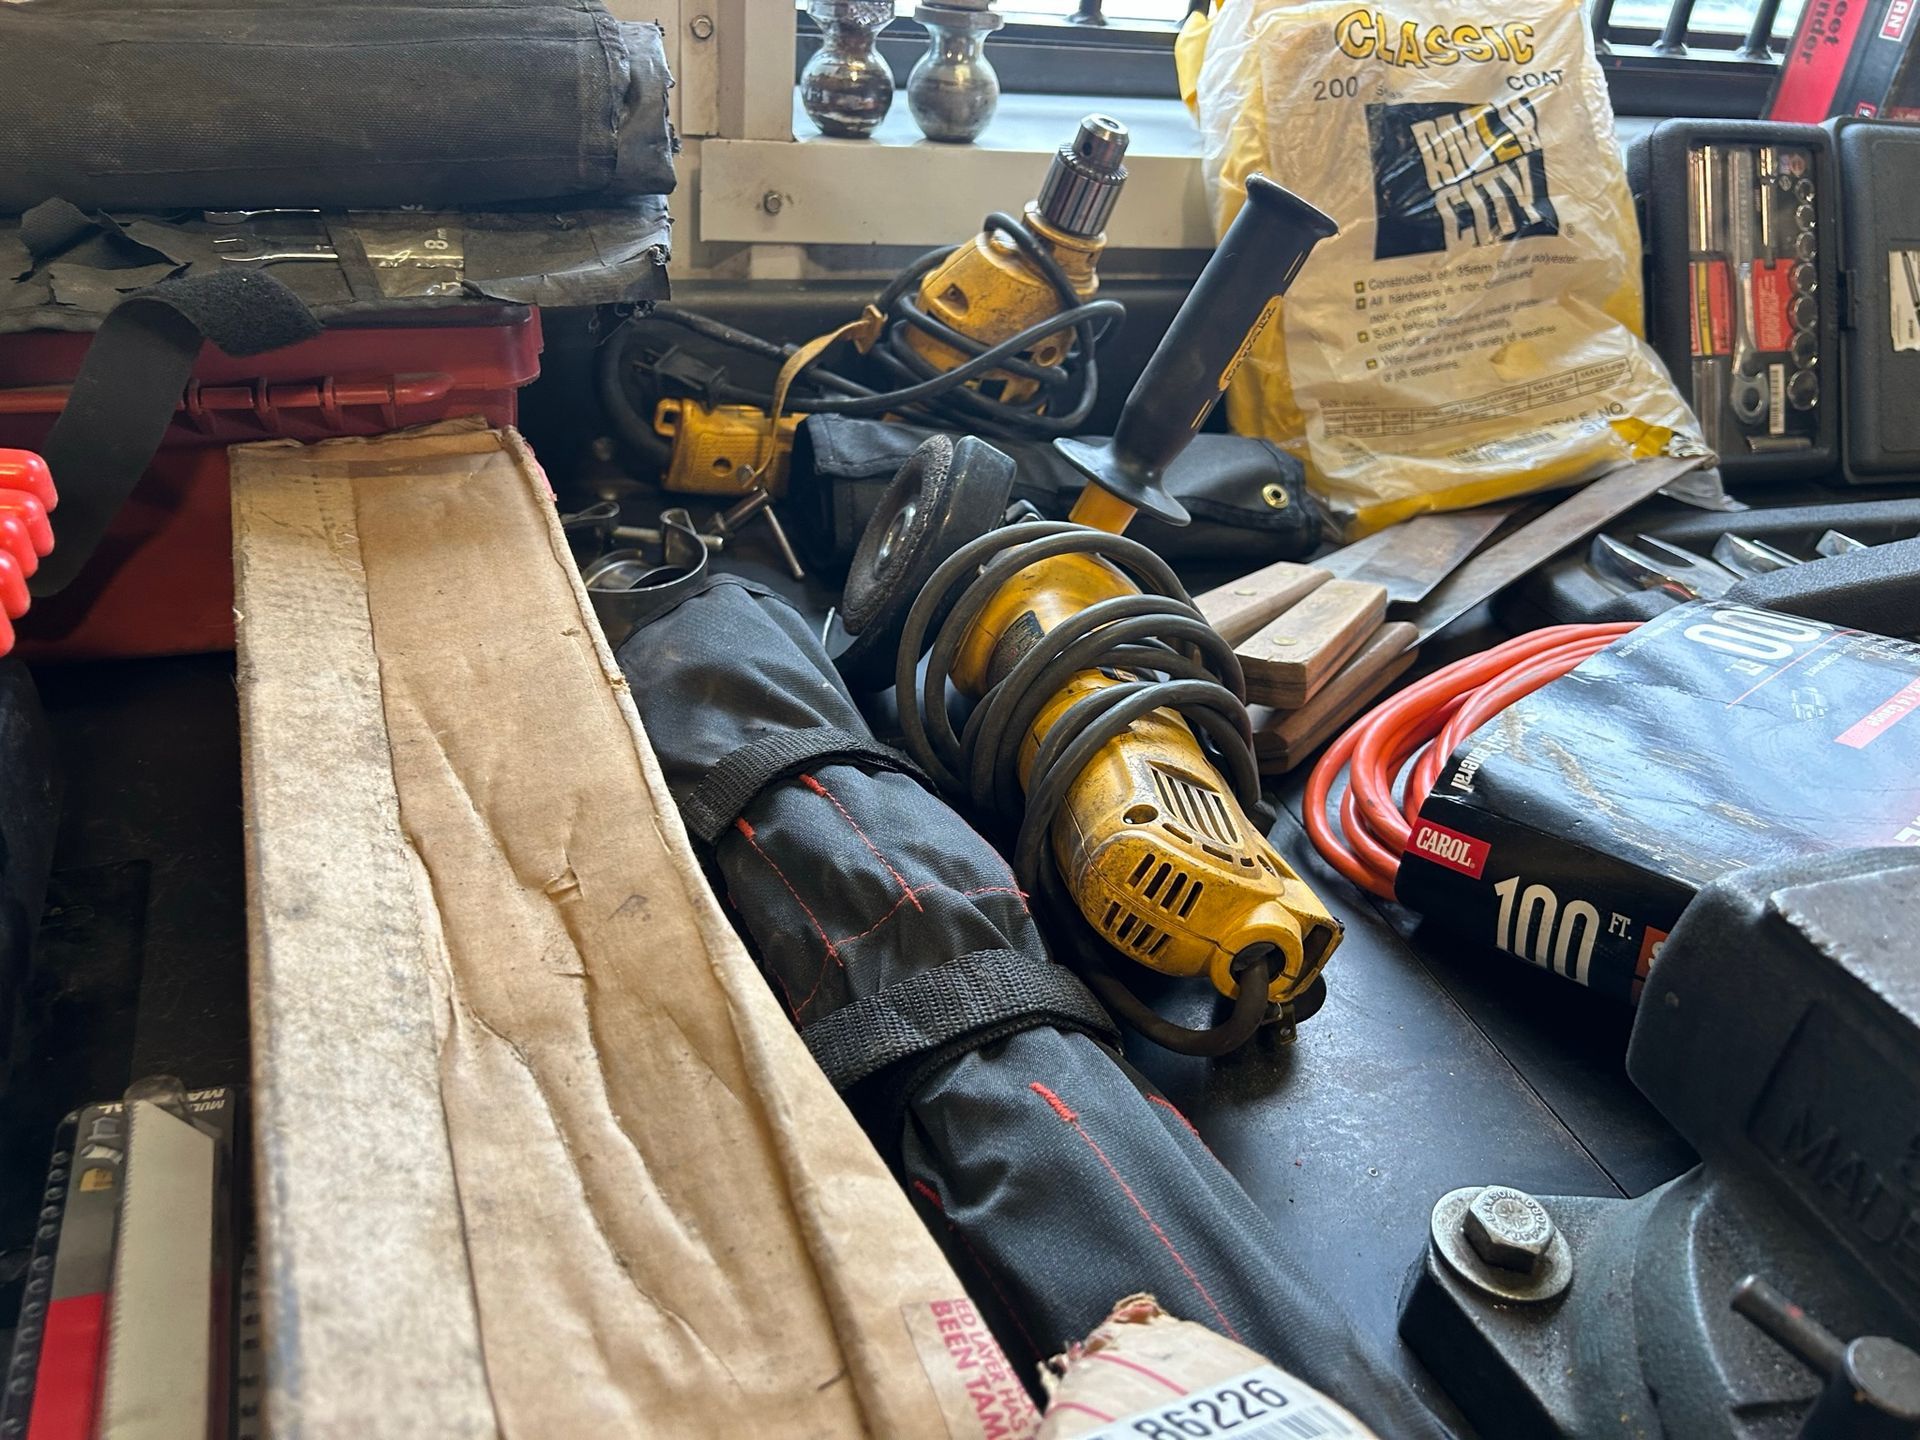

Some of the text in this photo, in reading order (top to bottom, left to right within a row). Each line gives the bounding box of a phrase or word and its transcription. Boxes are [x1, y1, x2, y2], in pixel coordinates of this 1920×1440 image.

[1335, 9, 1535, 69] CLASSIC
[1313, 76, 1359, 101] 200
[1506, 69, 1564, 91] COAT
[1410, 97, 1542, 191] RIVER
[1435, 156, 1542, 251] CITY
[1415, 826, 1473, 868] CAROL
[1494, 876, 1600, 987] 100
[1607, 911, 1633, 941] FT.
[930, 1301, 980, 1371] BEEN
[968, 1331, 1007, 1383] LAYER
[997, 1388, 1029, 1432] HAS
[1131, 1379, 1289, 1440] 86226
